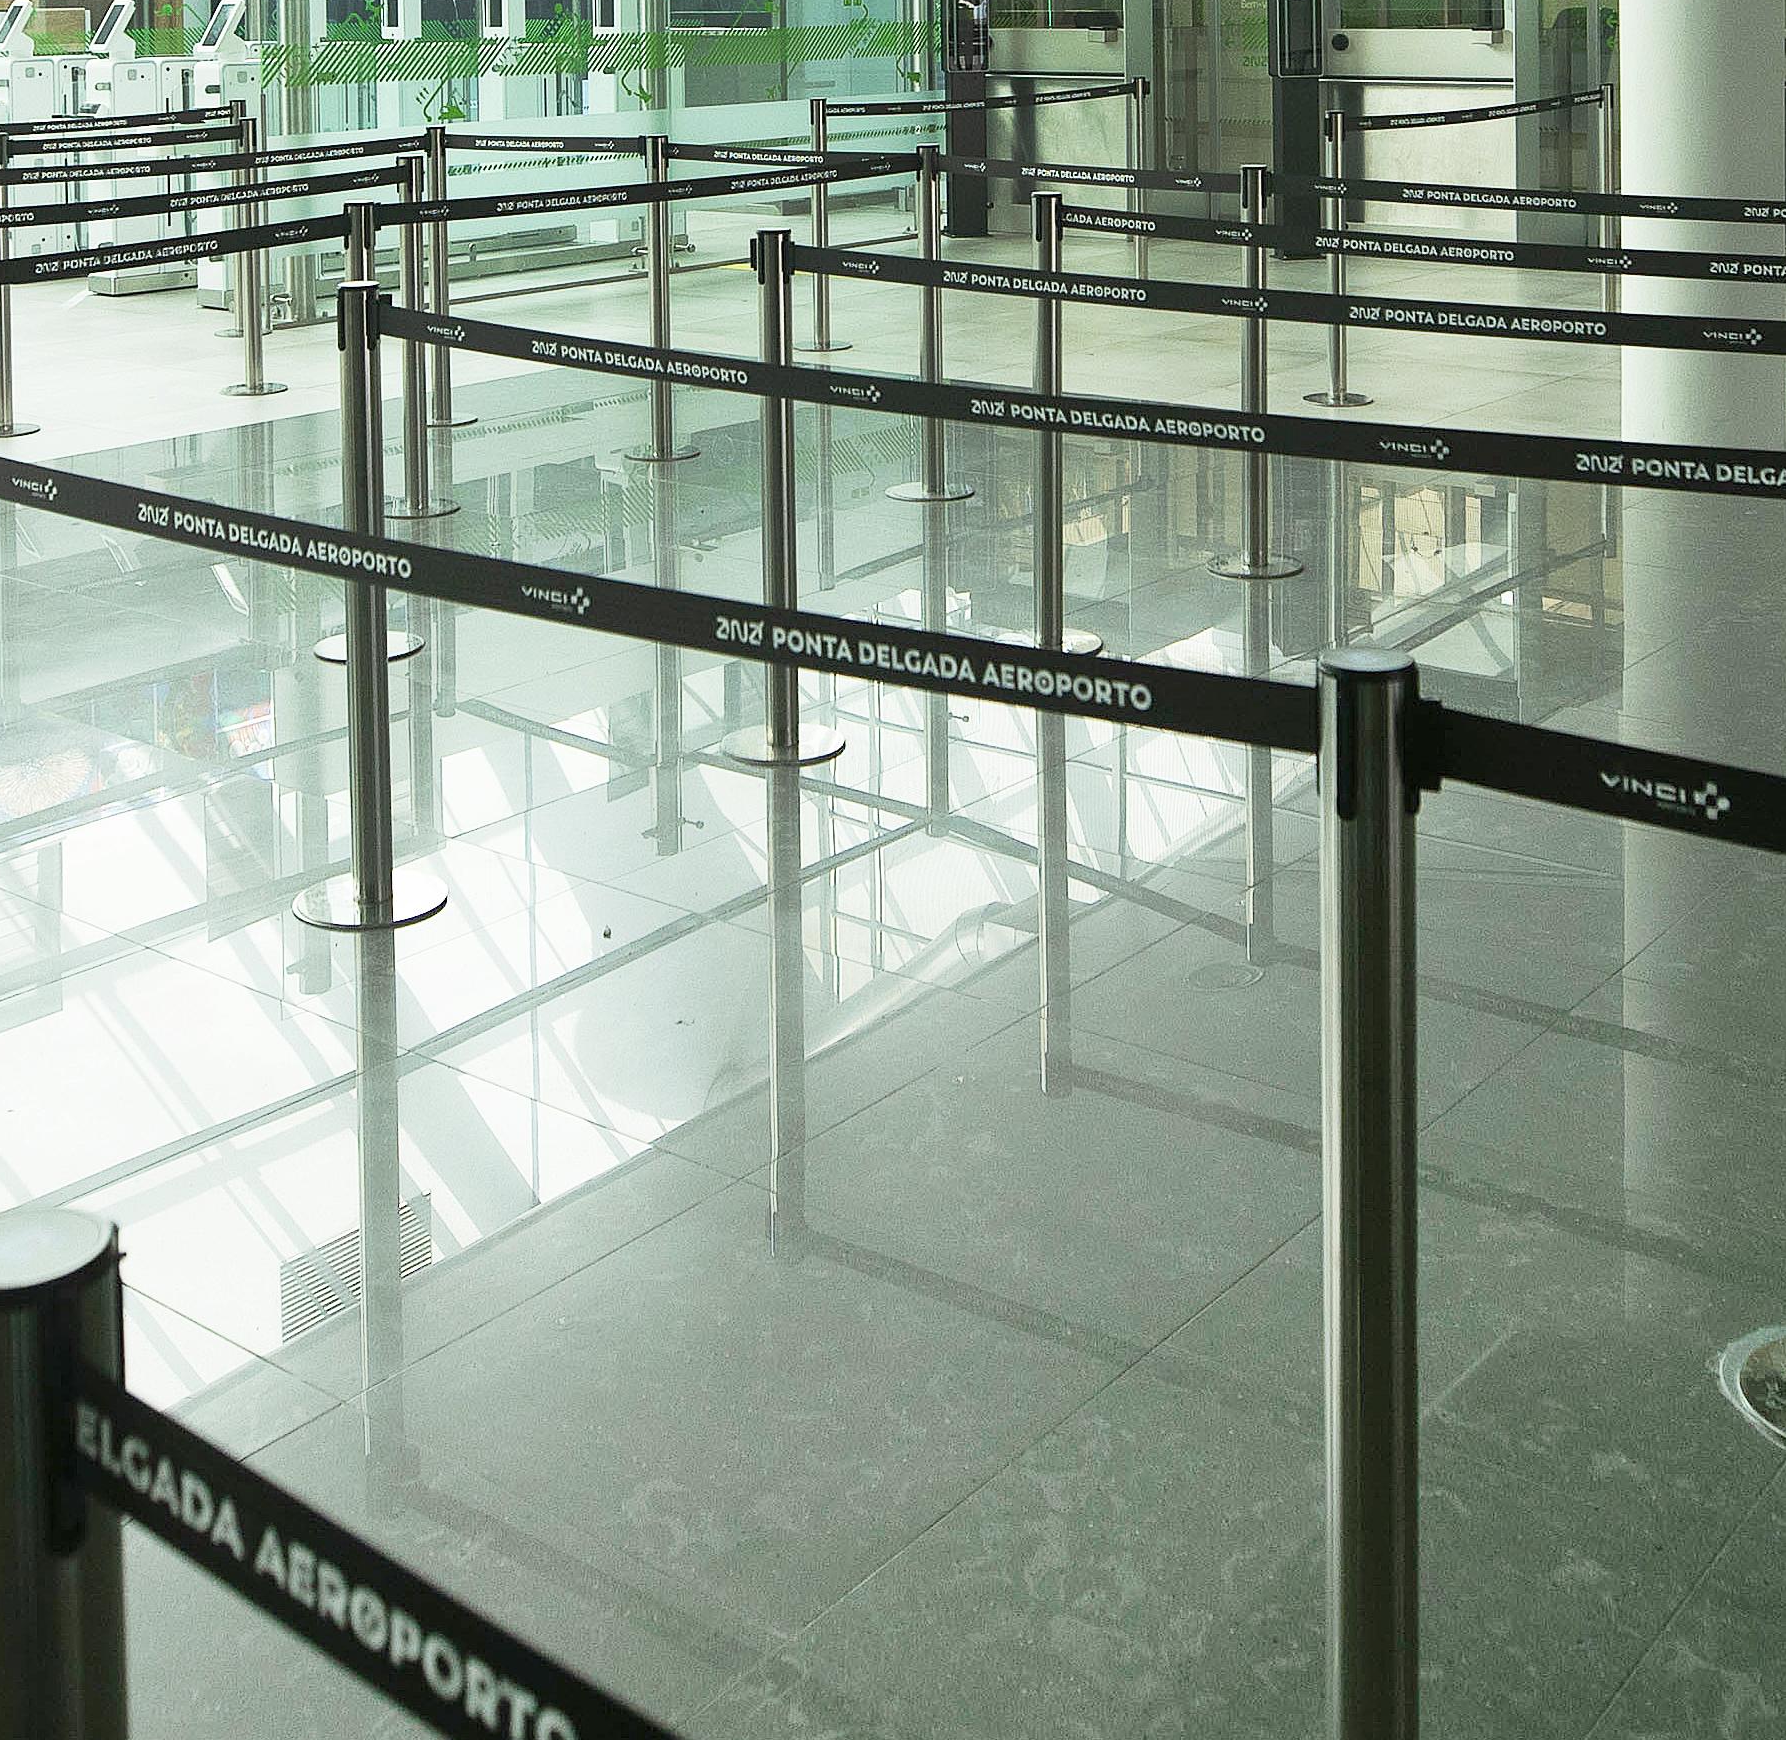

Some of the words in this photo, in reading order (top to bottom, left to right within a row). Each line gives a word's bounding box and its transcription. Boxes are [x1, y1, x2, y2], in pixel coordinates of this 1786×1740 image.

[1036, 168, 1059, 177] PONTA
[1060, 170, 1091, 180] DELGADA
[1092, 172, 1134, 182] AEROPORTO
[1427, 190, 1461, 201] PONTA
[1463, 192, 1511, 204] DELGADA
[1512, 196, 1577, 208] AEROPORTO
[1343, 239, 1382, 251] PONTA
[1384, 242, 1438, 255] DELGADA
[1440, 246, 1514, 261] AEROPORTO
[971, 273, 1010, 288] PONTA
[1013, 278, 1068, 293] DELGADA
[1070, 284, 1146, 300] AEROPORTO
[1385, 309, 1435, 324] PONTA
[1438, 313, 1507, 328] DELGADA
[1510, 318, 1606, 335] AEROPORTO
[561, 345, 603, 363] PONTA
[604, 352, 664, 372] DELGADA
[666, 361, 748, 383] AEROPORTO
[1010, 404, 1067, 423] PONTA
[1070, 410, 1150, 431] DELGADA
[1154, 419, 1265, 442] AEROPORTO
[1631, 458, 1710, 479] PONTA
[174, 511, 225, 539] PONTA
[228, 523, 303, 555] DELGADA
[306, 541, 411, 577] AEROPORTO
[772, 627, 853, 661] PONTA
[858, 642, 975, 681] DELGADA
[982, 664, 1151, 709] AEROPORTO
[74, 1403, 246, 1561] ELGADA
